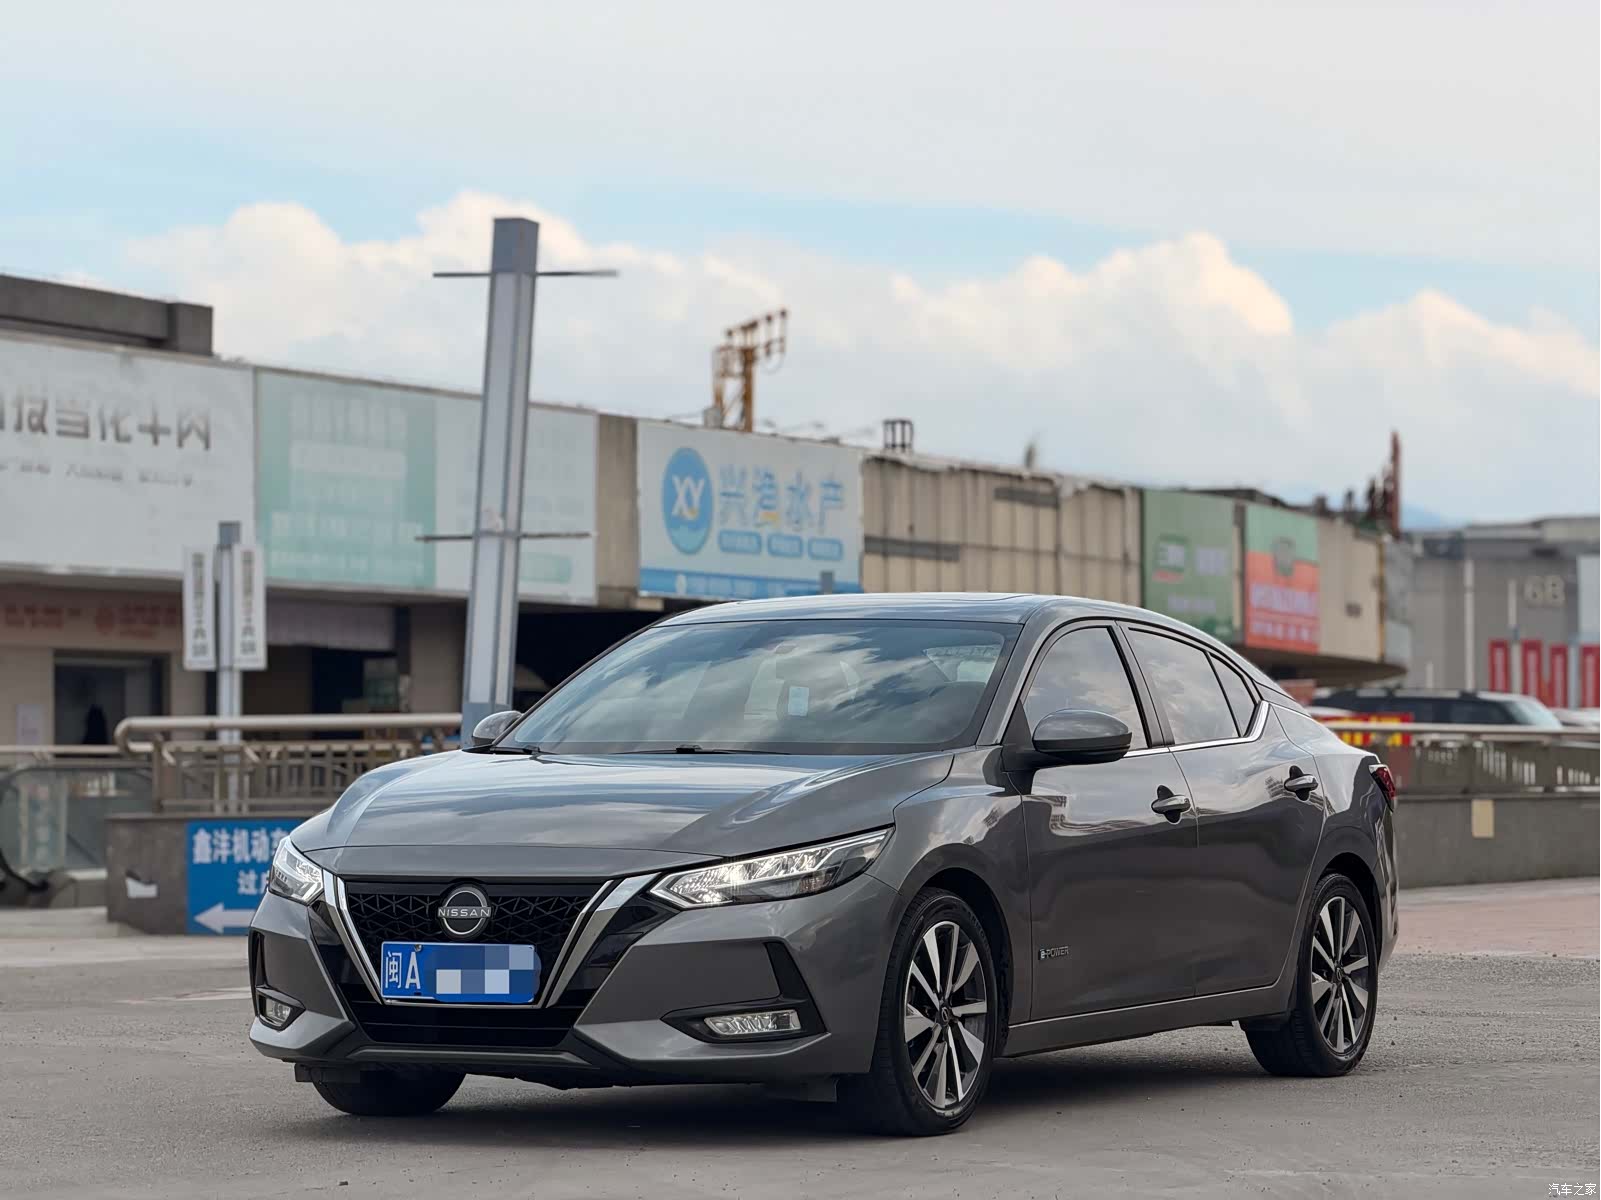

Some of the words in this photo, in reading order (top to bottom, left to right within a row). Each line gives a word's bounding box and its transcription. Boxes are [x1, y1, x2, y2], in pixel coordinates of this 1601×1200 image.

[671, 474, 705, 521] XY
[1523, 575, 1566, 606] 6B
[438, 908, 491, 918] NISSAN
